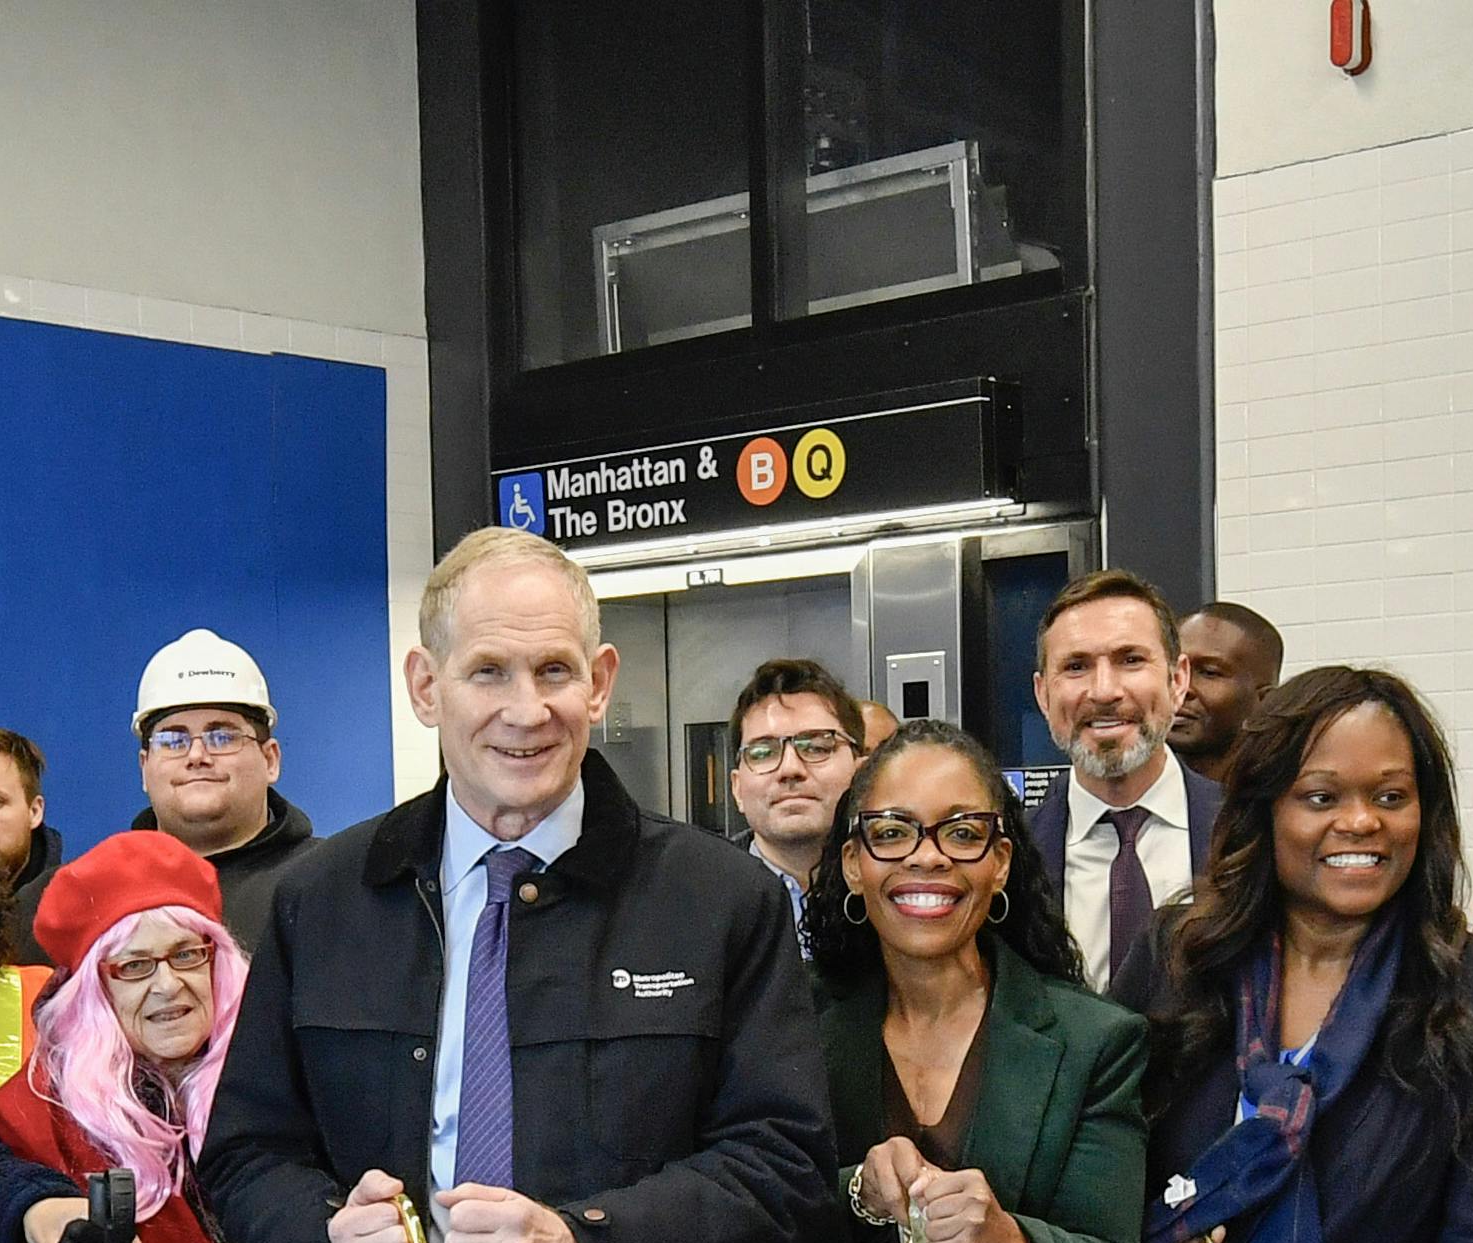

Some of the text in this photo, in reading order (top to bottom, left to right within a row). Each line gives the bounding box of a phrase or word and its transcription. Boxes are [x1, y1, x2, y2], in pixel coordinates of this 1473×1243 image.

[547, 446, 718, 500] Manhattan &
[750, 443, 834, 490] B Q
[548, 499, 687, 538] The Bronx
